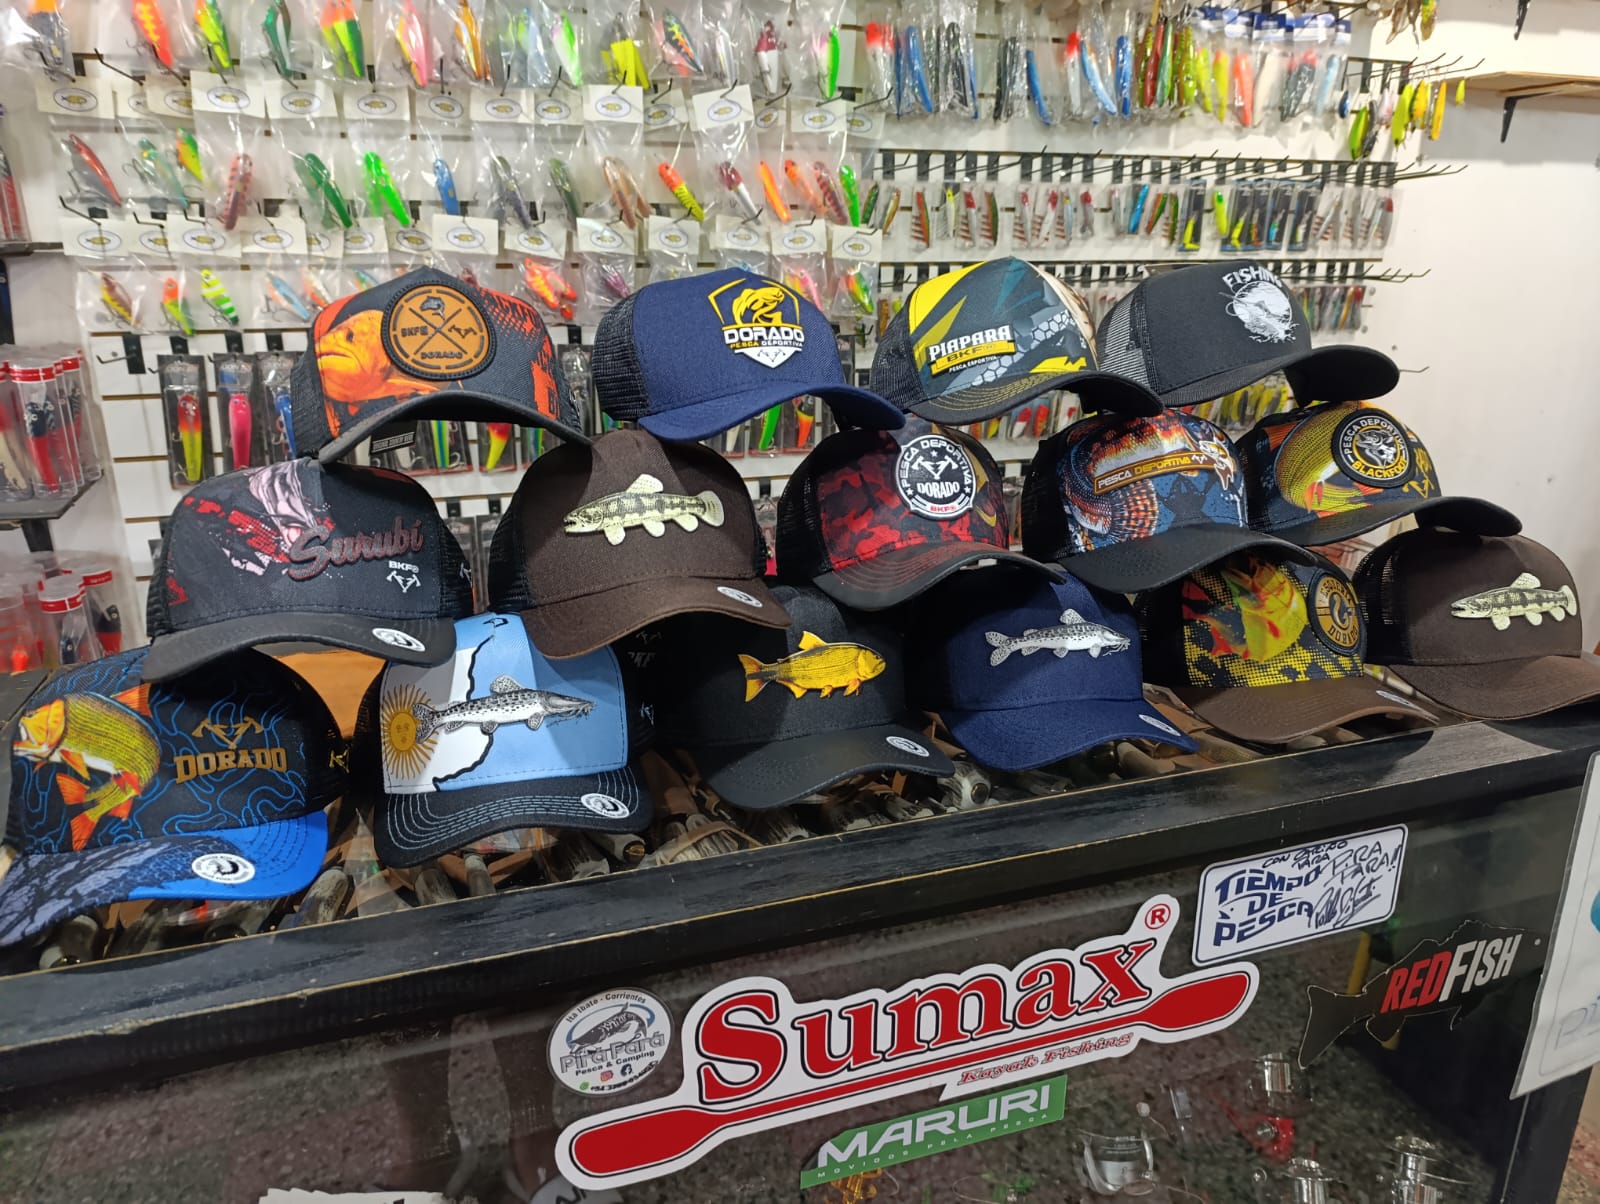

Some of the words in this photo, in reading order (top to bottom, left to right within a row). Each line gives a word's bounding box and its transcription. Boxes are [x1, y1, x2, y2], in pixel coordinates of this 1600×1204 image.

[724, 327, 805, 344] DORADO
[730, 341, 760, 349] PESCA
[761, 340, 803, 348] DEPORTIVA
[929, 325, 1014, 362] PIAPARA
[421, 351, 463, 360] DORADO
[949, 363, 967, 373] PESCA
[1343, 425, 1361, 455] PESCA
[900, 447, 920, 488] PESCA
[920, 439, 973, 486] DEPORTIVA
[1098, 470, 1132, 489] PESCA
[1134, 456, 1192, 475] DEPORTIVA
[917, 481, 960, 499] DORADO
[288, 516, 424, 581] Surubi
[173, 747, 287, 784] DORADO
[1262, 854, 1291, 869] CON
[1215, 865, 1321, 905] TIEMPO
[1248, 892, 1283, 916] DE
[1213, 901, 1314, 947] PESCA
[1380, 934, 1523, 1014] REDFISH
[605, 992, 646, 1004] Corrientes
[695, 937, 1157, 1101] Sumax
[576, 1065, 603, 1076] Pesca
[616, 1050, 655, 1065] Camping
[957, 1053, 1038, 1086] Kayak
[1041, 1032, 1134, 1065] Fishing
[817, 1085, 1050, 1168] MARURI
[818, 1151, 909, 1178] MOVIDOS
[927, 1133, 973, 1149] PELA
[989, 1113, 1048, 1132] PESCA
